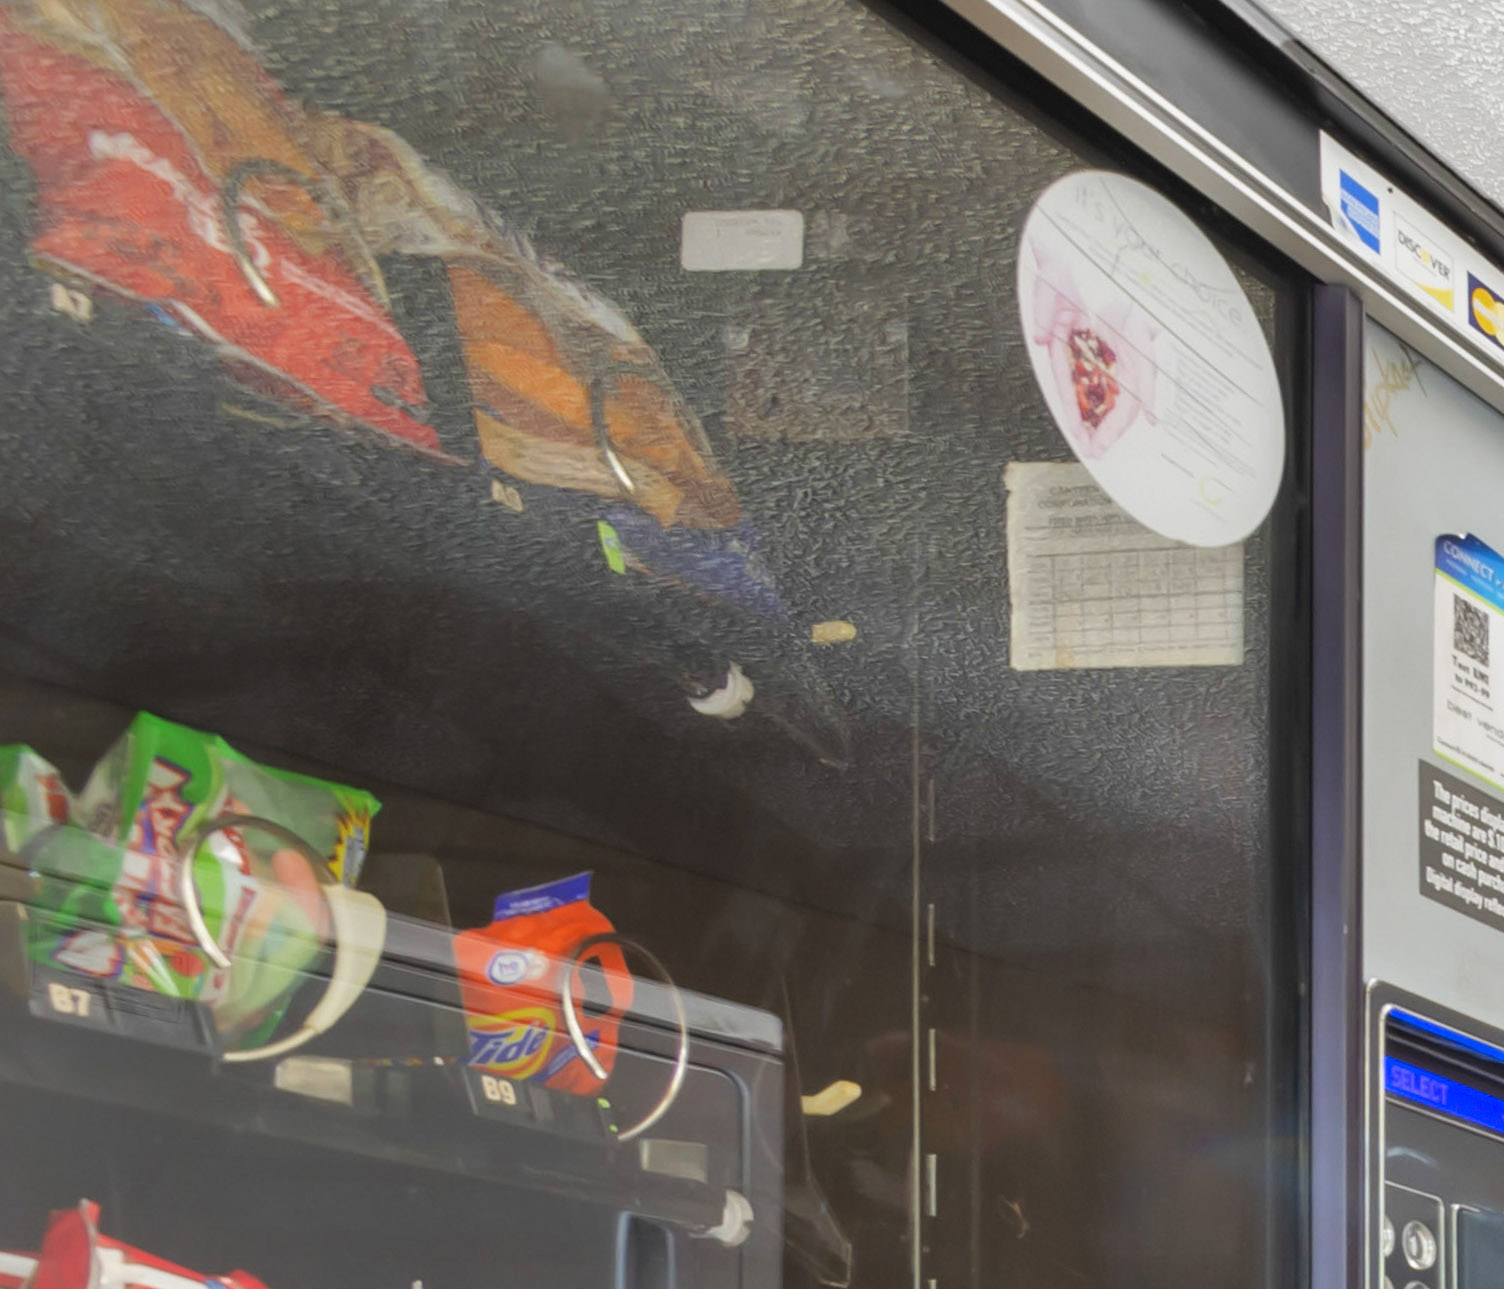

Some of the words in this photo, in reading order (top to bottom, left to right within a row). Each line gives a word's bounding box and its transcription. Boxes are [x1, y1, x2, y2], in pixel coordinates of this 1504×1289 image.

[1398, 230, 1451, 278] DISCOVER
[1443, 540, 1495, 582] CONNECT
[1433, 780, 1450, 804] The
[1451, 794, 1480, 821] prices
[1424, 819, 1440, 841] the
[1440, 830, 1464, 854] retail
[1464, 842, 1488, 865] price
[1432, 805, 1471, 835] machine
[1472, 825, 1487, 844] are
[1442, 852, 1455, 869] on
[1455, 859, 1478, 880] cash
[1425, 865, 1454, 893] Digital
[1454, 881, 1483, 911] display
[48, 982, 91, 1017] B7
[466, 1016, 549, 1067] Tide
[480, 1074, 517, 1106] B9
[1391, 1065, 1449, 1105] SELECT
